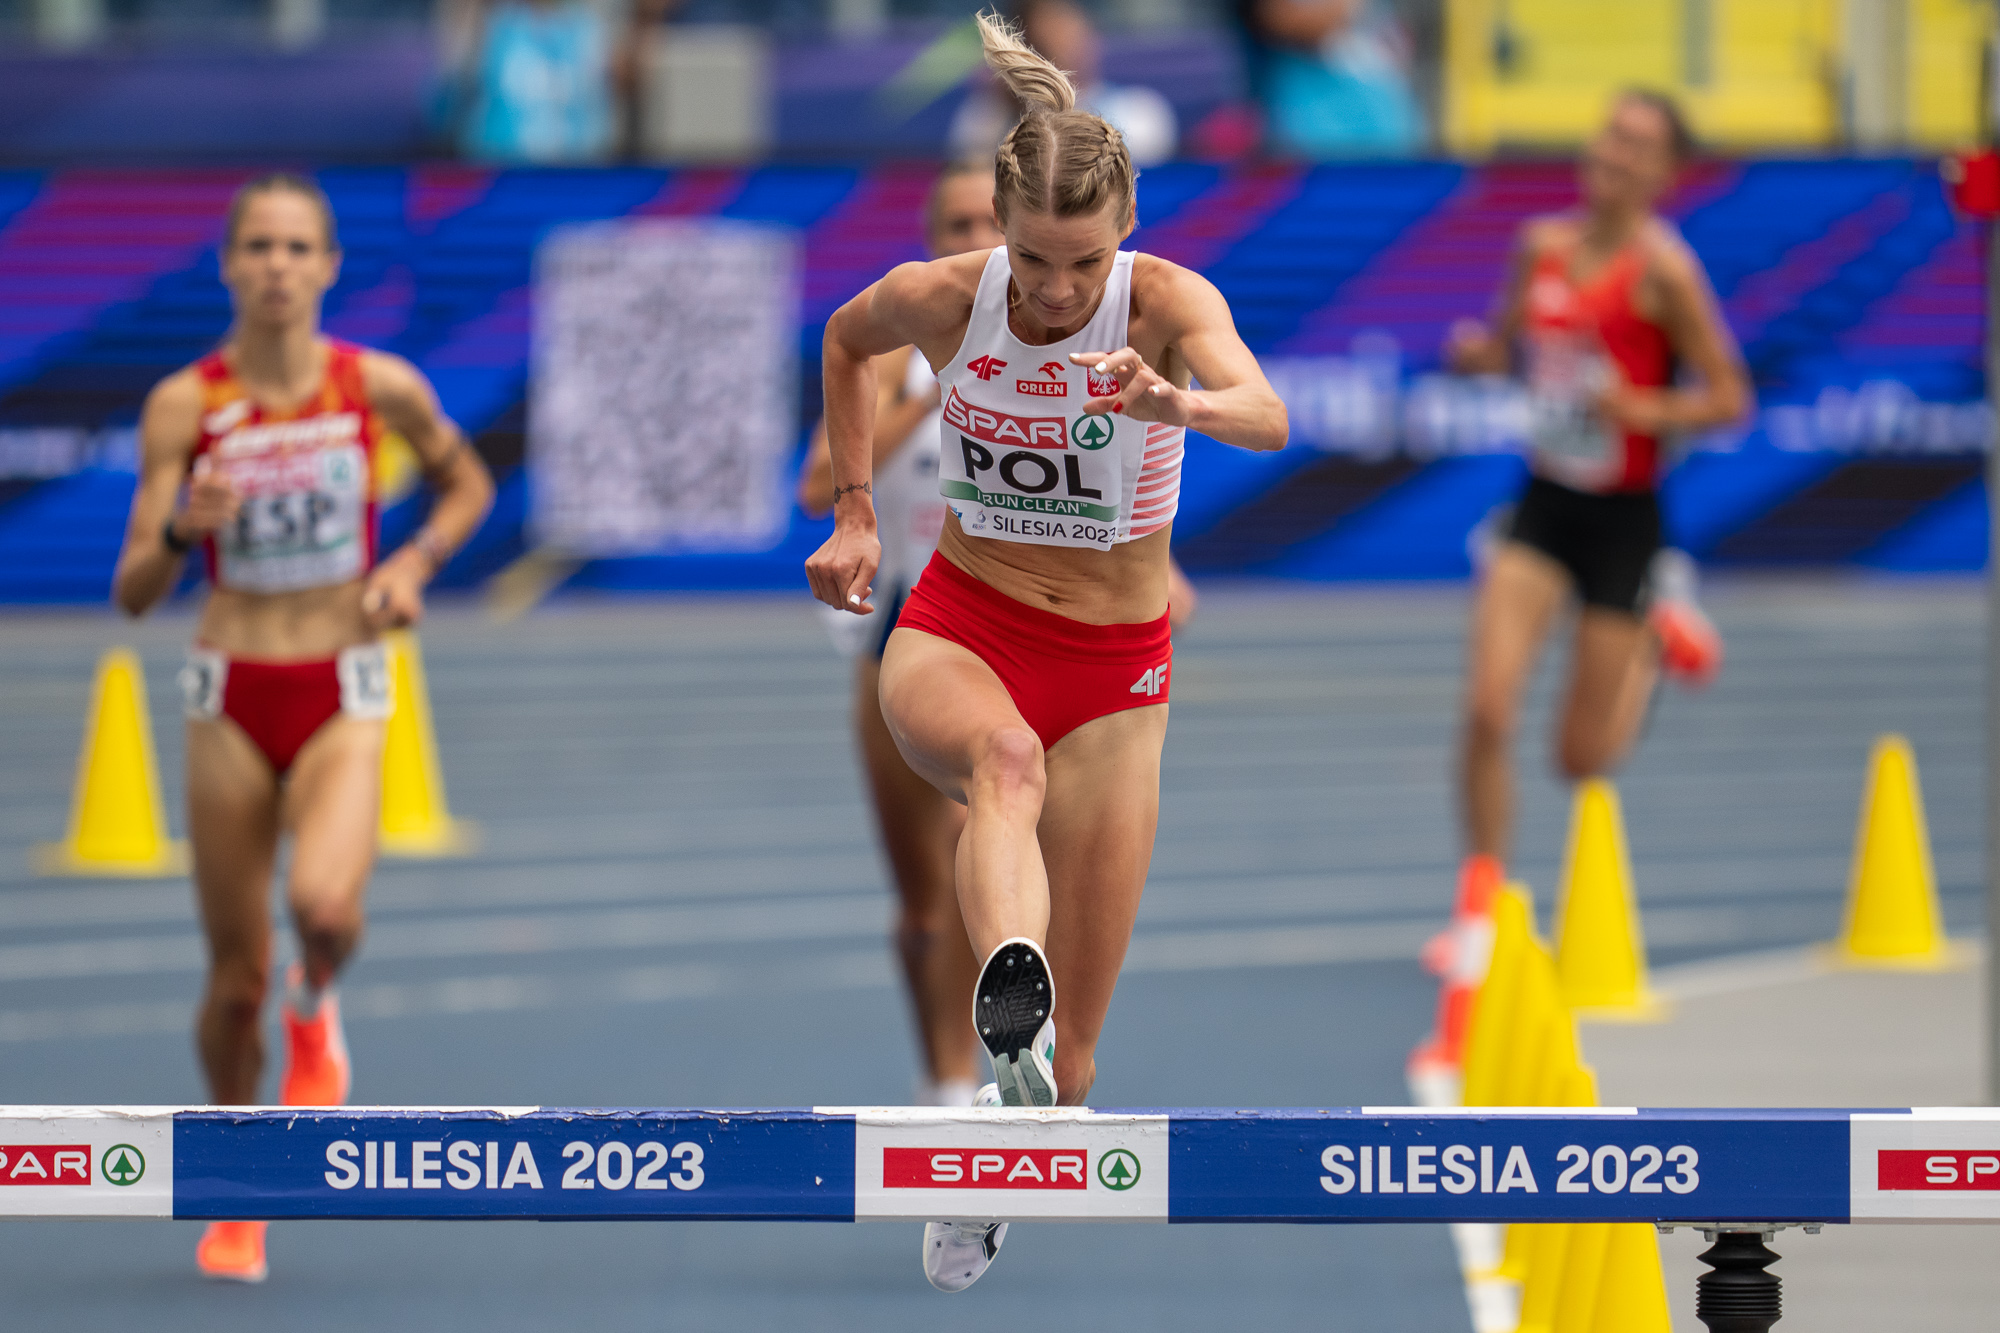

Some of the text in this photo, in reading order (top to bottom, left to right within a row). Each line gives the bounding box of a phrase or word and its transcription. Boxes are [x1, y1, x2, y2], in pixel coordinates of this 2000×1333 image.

[967, 354, 1008, 381] 4F
[1018, 382, 1065, 395] ORLEN
[946, 398, 1064, 445] SPAR
[960, 434, 1102, 500] POL
[982, 494, 1019, 508] RUN
[993, 514, 1067, 538] SILESIA
[1129, 662, 1168, 697] 4F
[0, 1151, 87, 1179] AR
[325, 1141, 704, 1190] SILESIA 2023
[931, 1155, 1083, 1182] SPAR
[1320, 1145, 1699, 1194] SILESIA 2023
